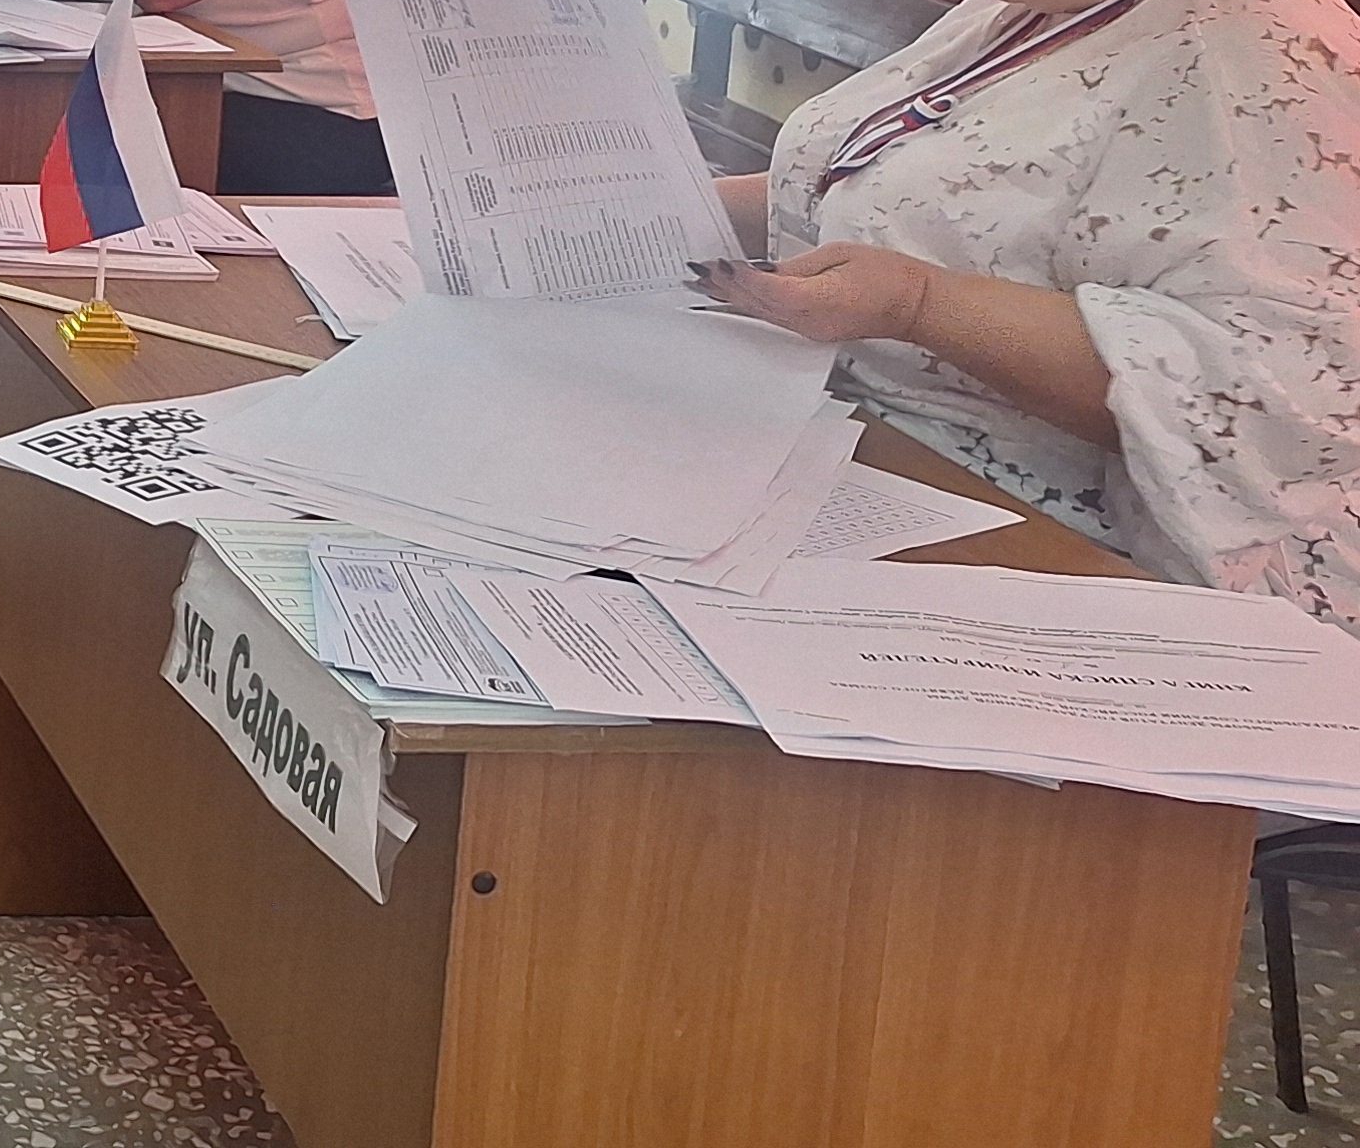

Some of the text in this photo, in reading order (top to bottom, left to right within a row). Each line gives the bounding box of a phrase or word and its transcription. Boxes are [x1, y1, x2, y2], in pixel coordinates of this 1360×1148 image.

[177, 601, 217, 694] ул.
[225, 634, 344, 835] Садовая
[859, 651, 1252, 694] КНИГА СПИСКА ИЗБИРАТЕЛЕЙ
